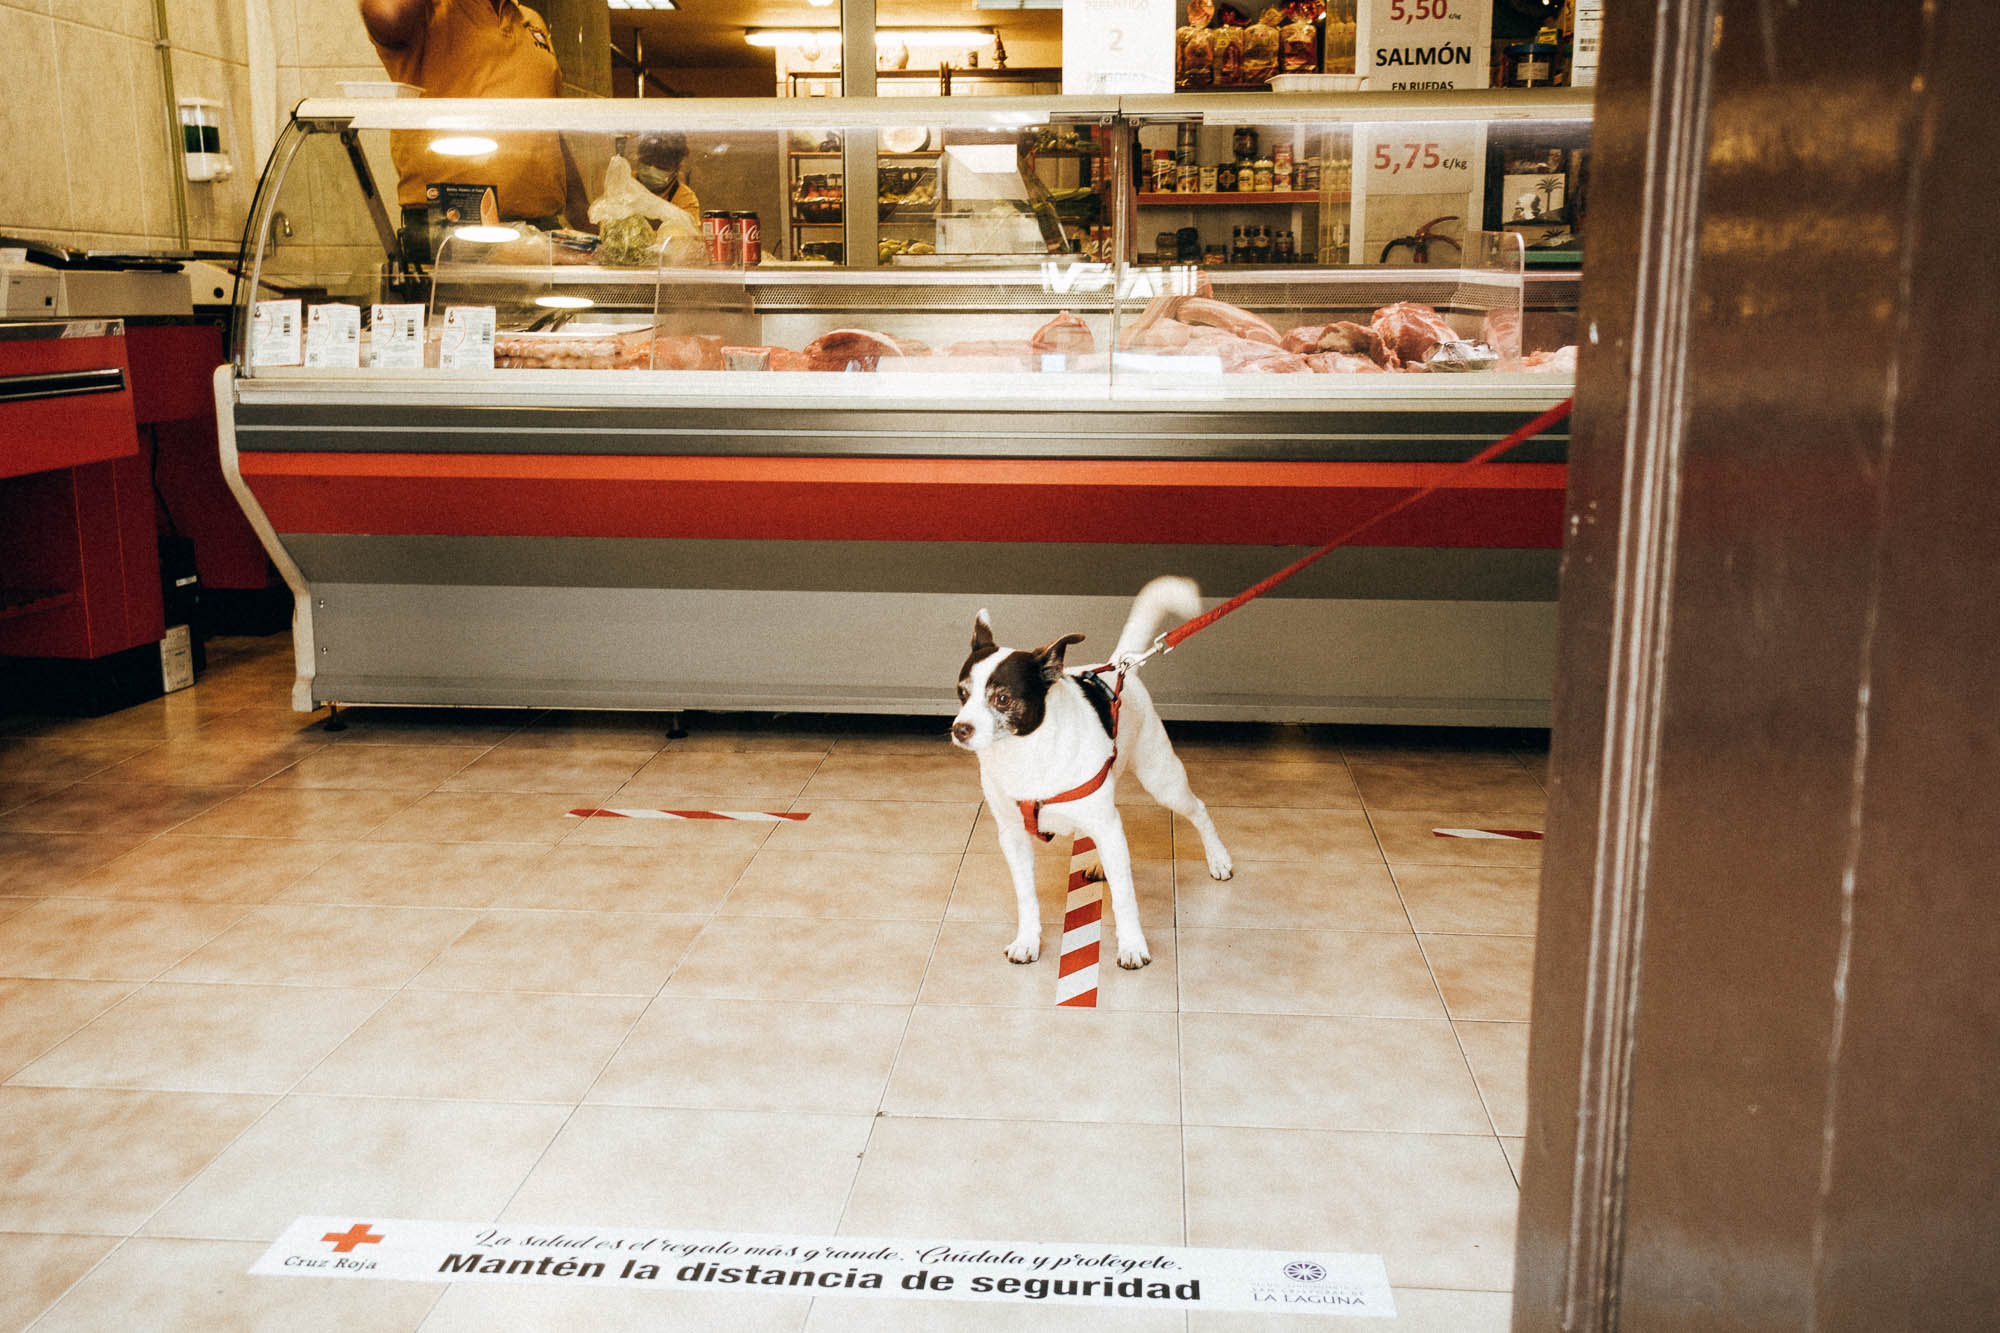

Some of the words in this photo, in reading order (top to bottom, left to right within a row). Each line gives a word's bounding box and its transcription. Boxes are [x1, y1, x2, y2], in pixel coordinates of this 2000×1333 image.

[1390, 0, 1448, 25] 5,50
[1110, 28, 1123, 51] 2
[1375, 41, 1471, 67] SALMÓN
[1374, 143, 1440, 175] 5,75
[1442, 158, 1468, 170] €/kg
[475, 1229, 512, 1248] La
[519, 1234, 598, 1249] salud
[594, 1238, 625, 1249] es
[628, 1238, 659, 1251] el
[661, 1239, 739, 1256] regalo
[744, 1244, 799, 1257] más
[803, 1246, 905, 1263] grande.
[915, 1246, 1025, 1265] Cuídala
[1032, 1254, 1051, 1269] y
[284, 1255, 329, 1268] Cruz
[333, 1257, 378, 1272] Roja
[438, 1253, 606, 1278] Mantén
[620, 1259, 661, 1280] la
[676, 1262, 884, 1289] distancia
[901, 1270, 955, 1291] de
[970, 1276, 1201, 1300] seguridad
[1253, 1293, 1278, 1302] LA
[1284, 1294, 1366, 1305] LAGUNA
